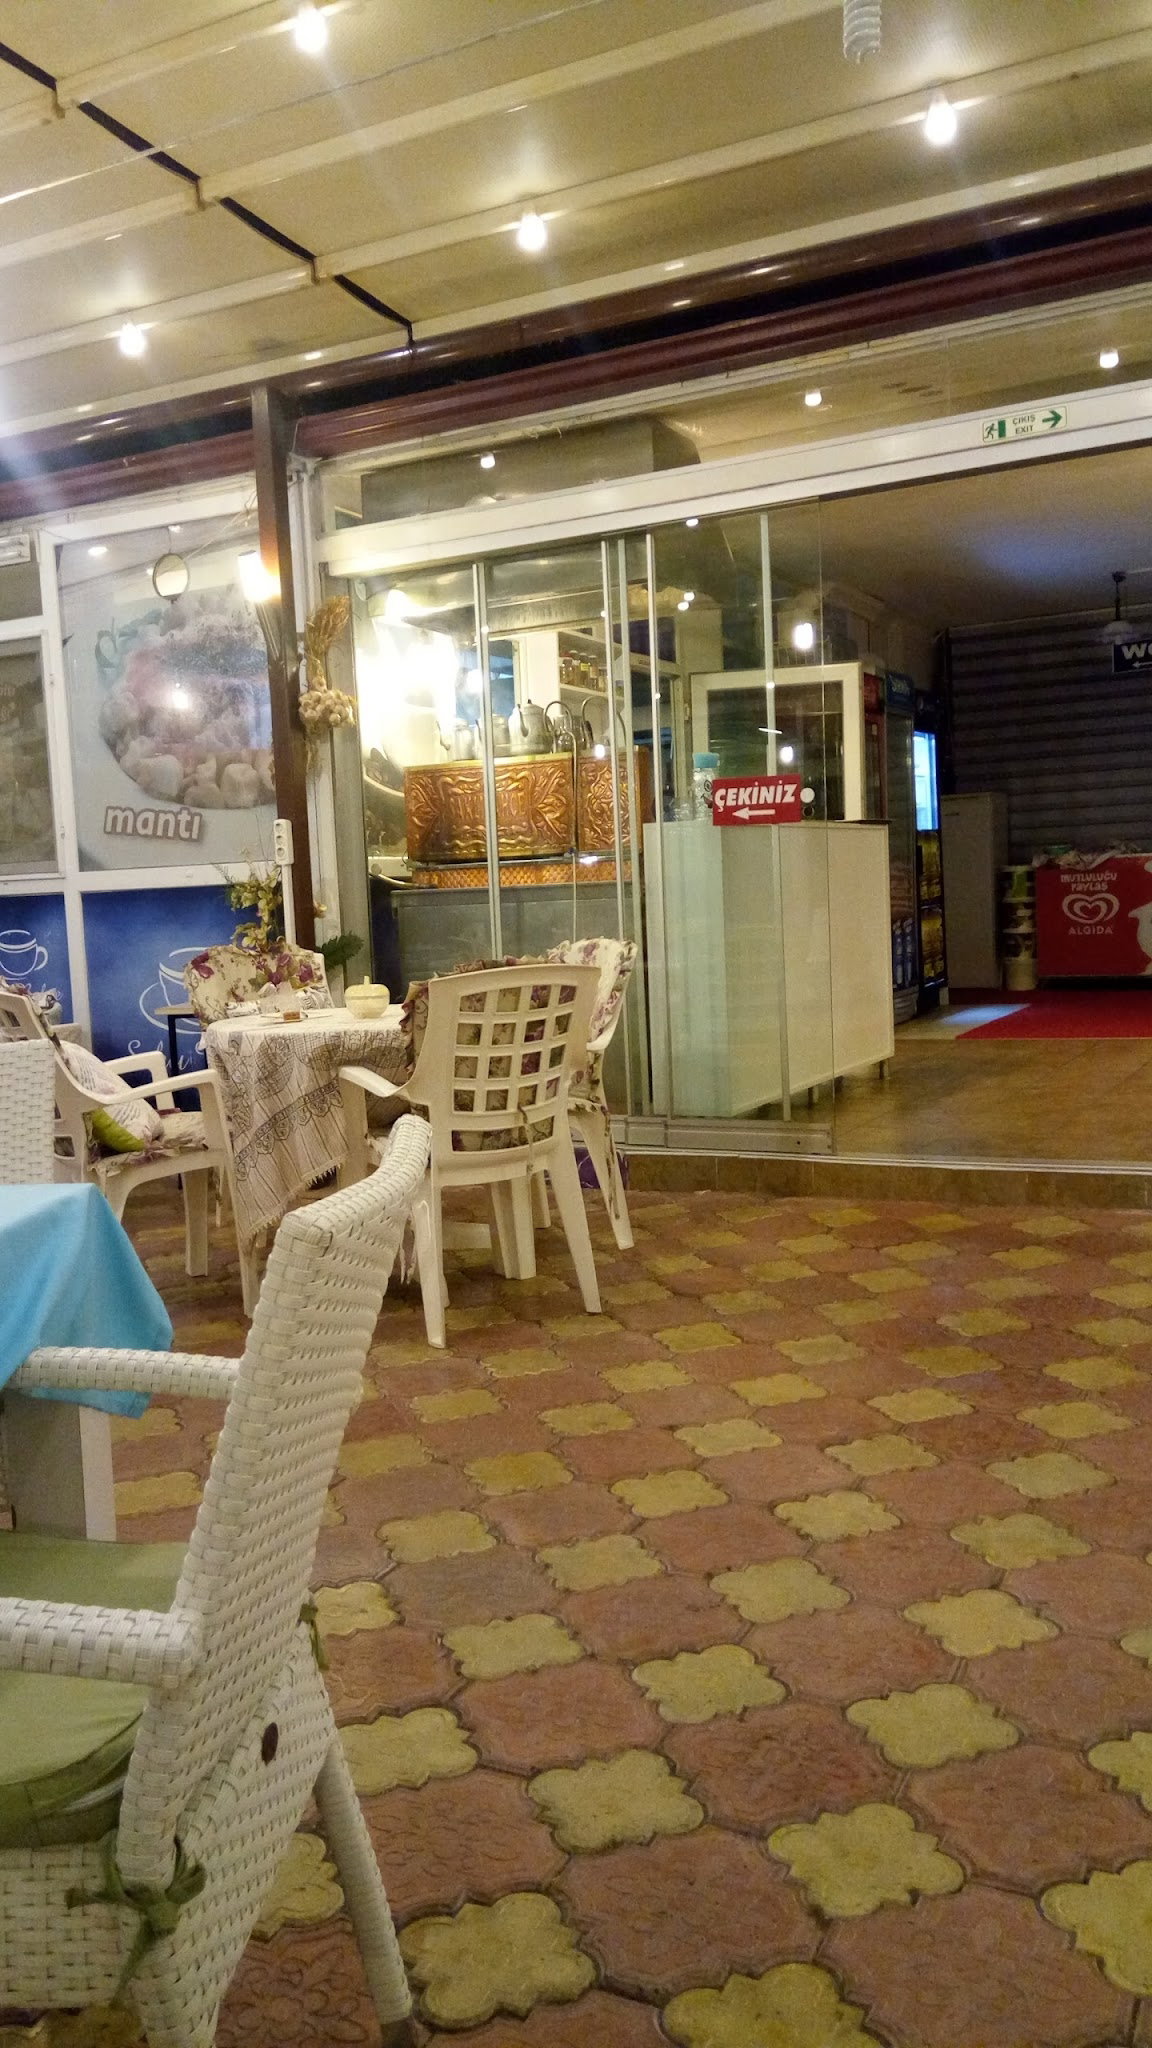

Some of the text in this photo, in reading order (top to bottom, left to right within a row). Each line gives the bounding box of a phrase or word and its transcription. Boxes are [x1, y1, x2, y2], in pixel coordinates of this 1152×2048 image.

[1015, 425, 1034, 435] EXIT
[714, 780, 798, 813] ÇEKİNİZ
[104, 807, 202, 841] mantı
